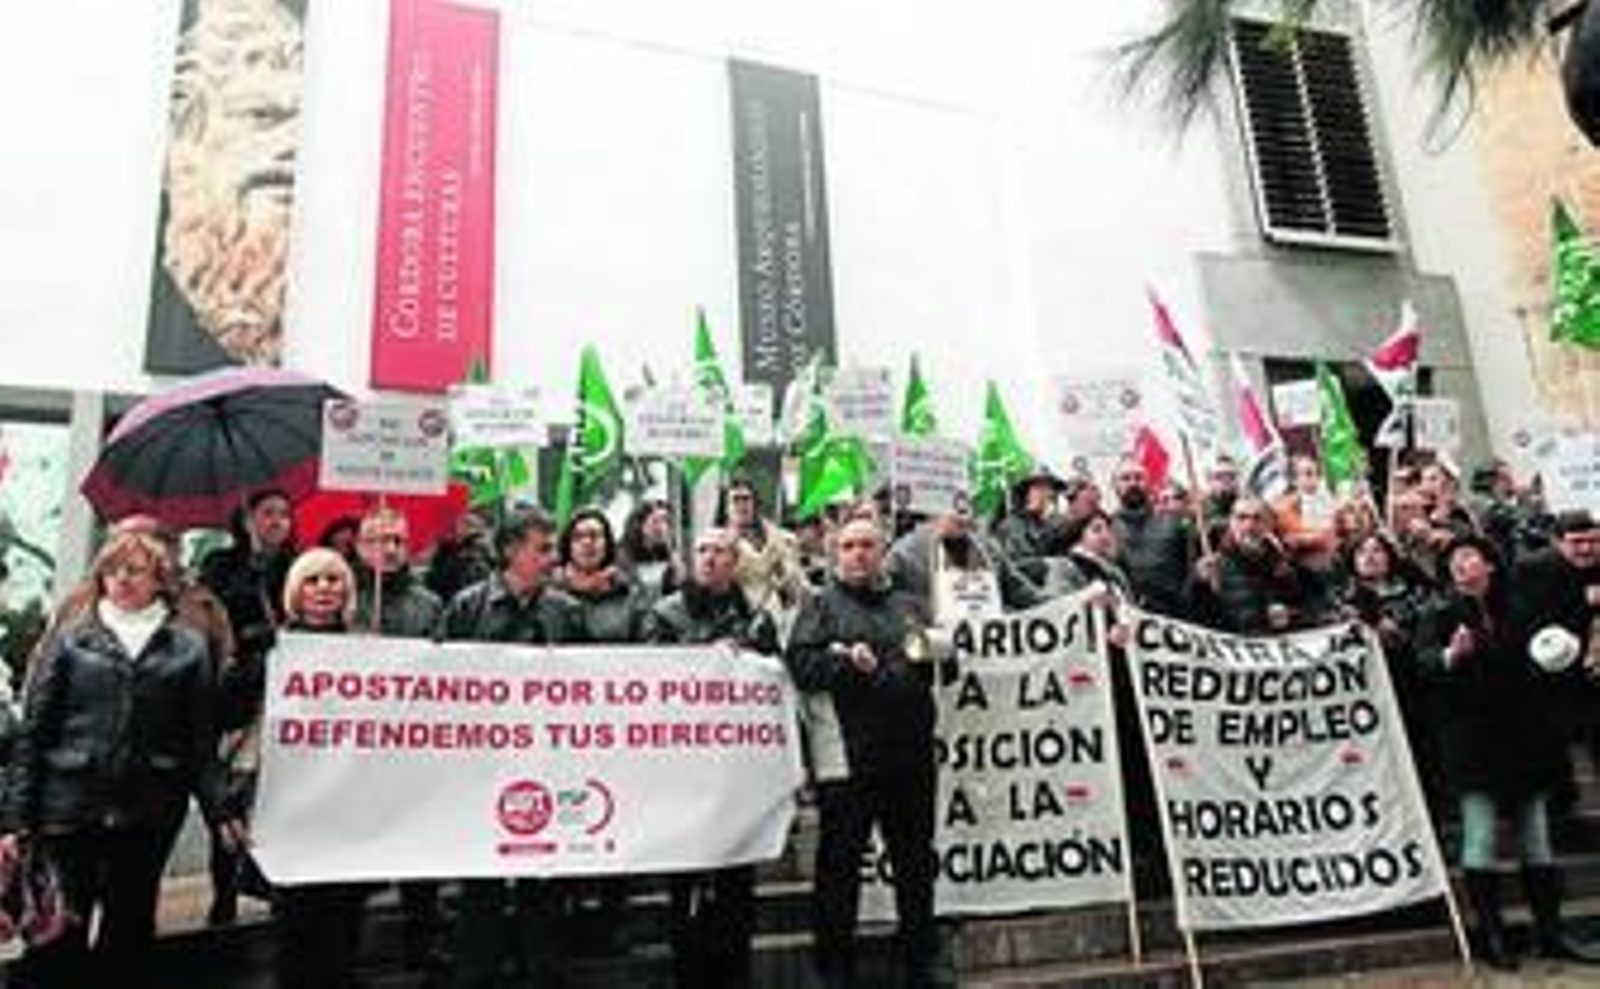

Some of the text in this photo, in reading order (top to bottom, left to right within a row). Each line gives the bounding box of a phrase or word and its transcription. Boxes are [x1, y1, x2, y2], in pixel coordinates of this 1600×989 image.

[283, 671, 511, 705] APOSTANDO
[522, 679, 594, 706] POR
[604, 679, 648, 706] LO
[956, 670, 1067, 710] A LA
[278, 718, 788, 750] DEFENDEMOS TUS DERECHOS
[1150, 699, 1380, 746] DE EMPLEO
[1245, 756, 1273, 790] Y
[946, 781, 1063, 827] A LA
[1168, 790, 1380, 839] HORARIOS
[1184, 841, 1423, 896] REDUCIDOS
